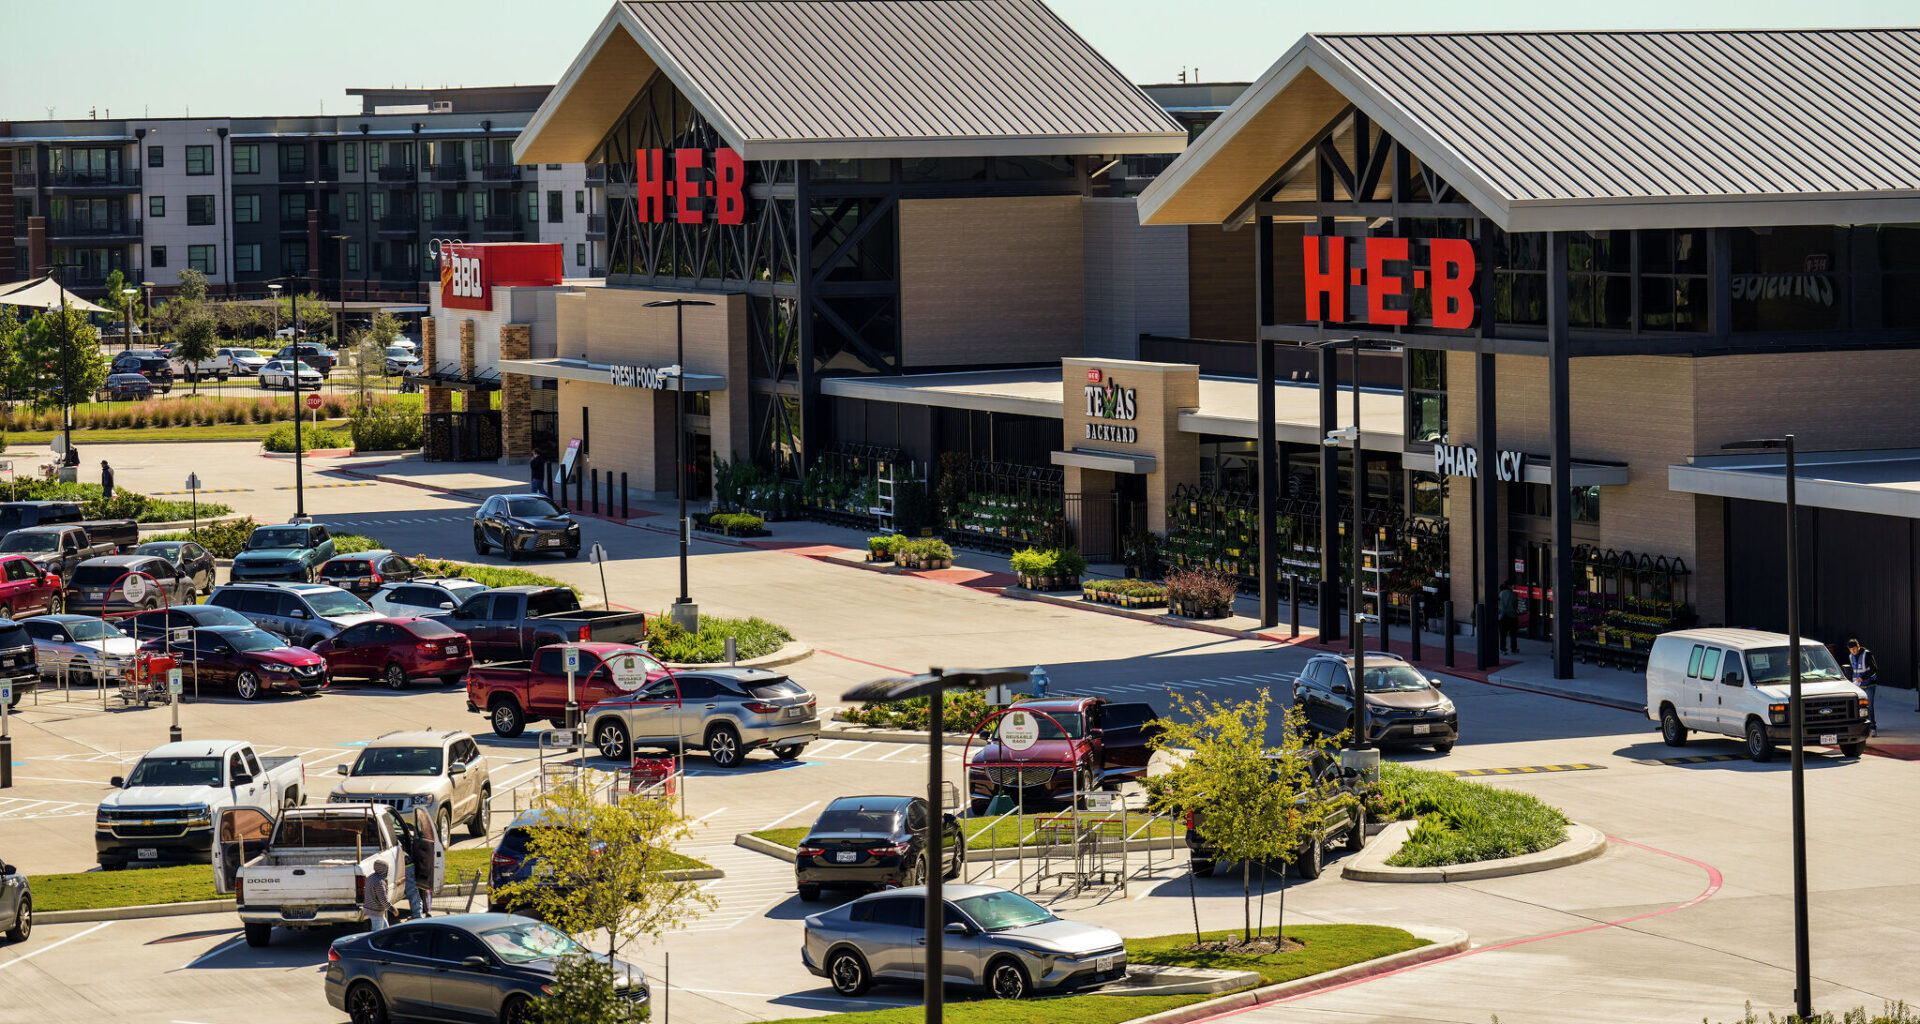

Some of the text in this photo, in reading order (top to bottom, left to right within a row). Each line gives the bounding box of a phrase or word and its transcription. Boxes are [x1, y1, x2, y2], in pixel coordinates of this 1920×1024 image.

[452, 257, 483, 298] BBQ
[610, 364, 664, 390] FRESH FOODS
[1085, 382, 1135, 420] TEXAS
[1085, 424, 1135, 443] BACKYARD
